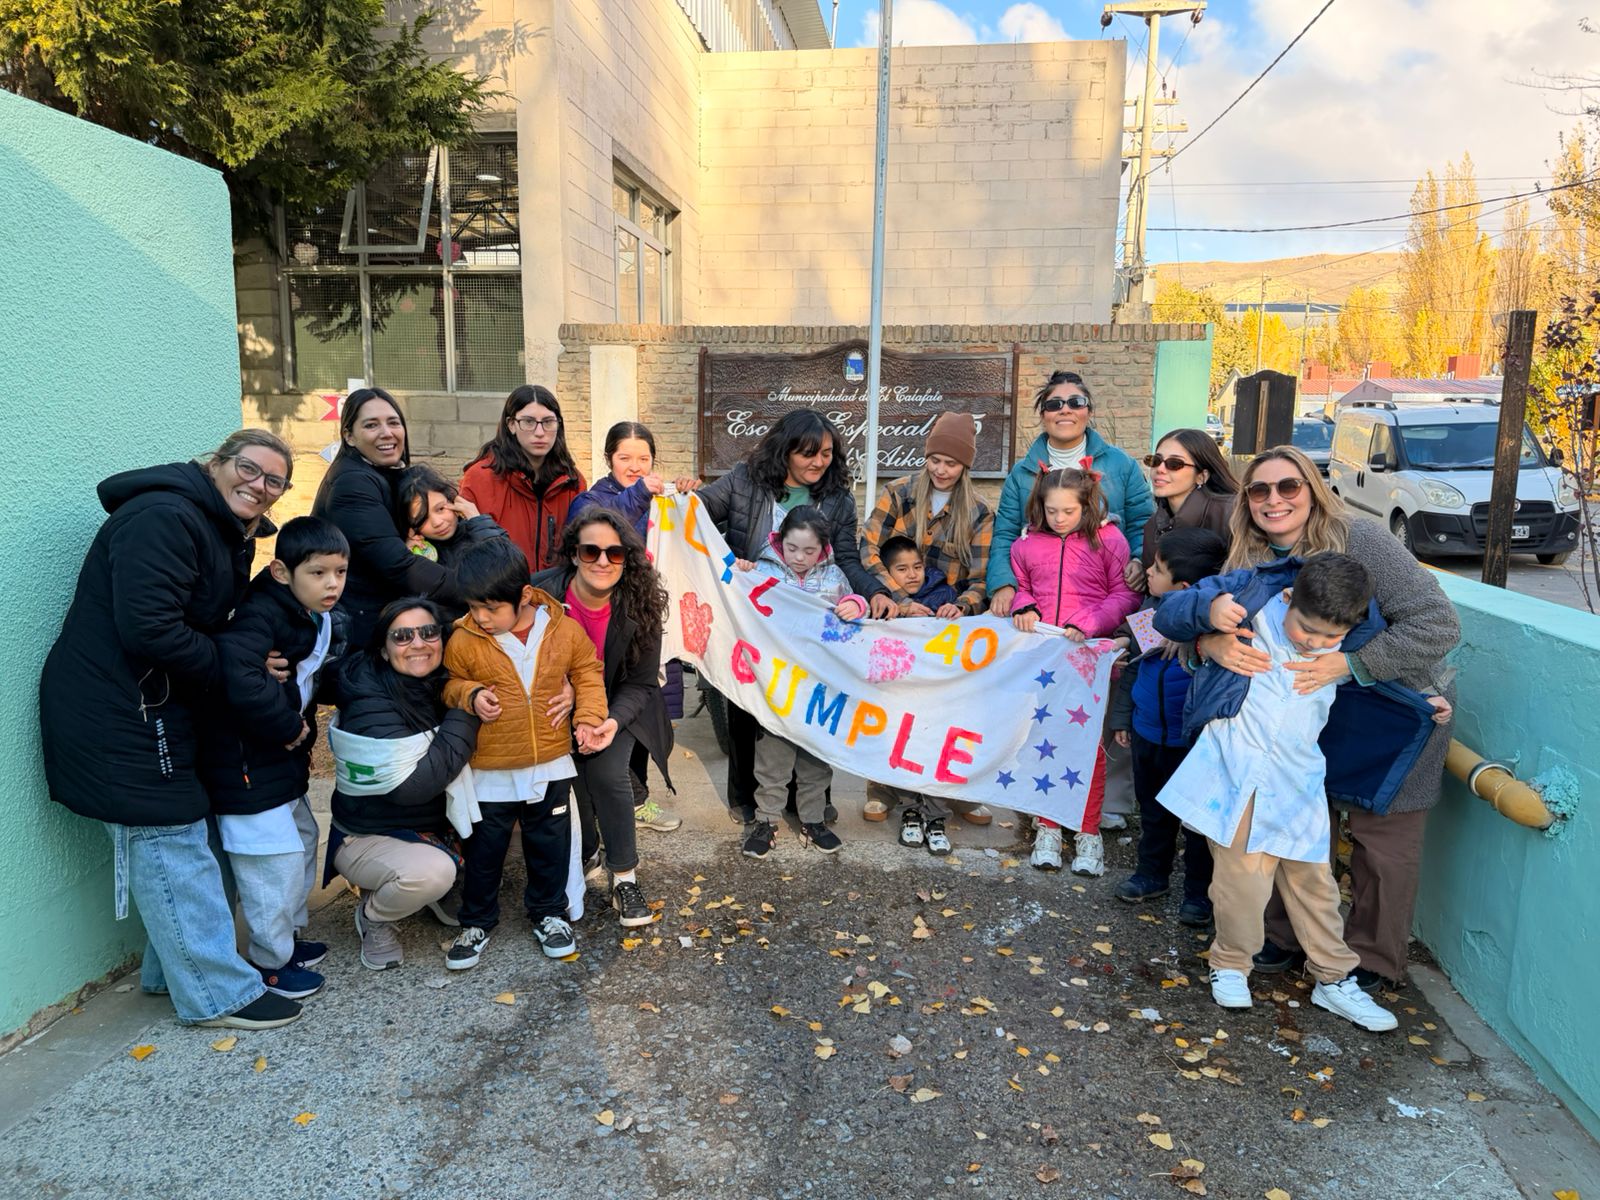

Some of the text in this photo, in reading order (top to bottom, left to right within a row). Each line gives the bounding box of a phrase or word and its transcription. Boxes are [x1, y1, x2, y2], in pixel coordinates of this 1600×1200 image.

[767, 386, 860, 406] Municipalidad
[924, 624, 999, 672] 40
[731, 638, 983, 784] CUMPLE
